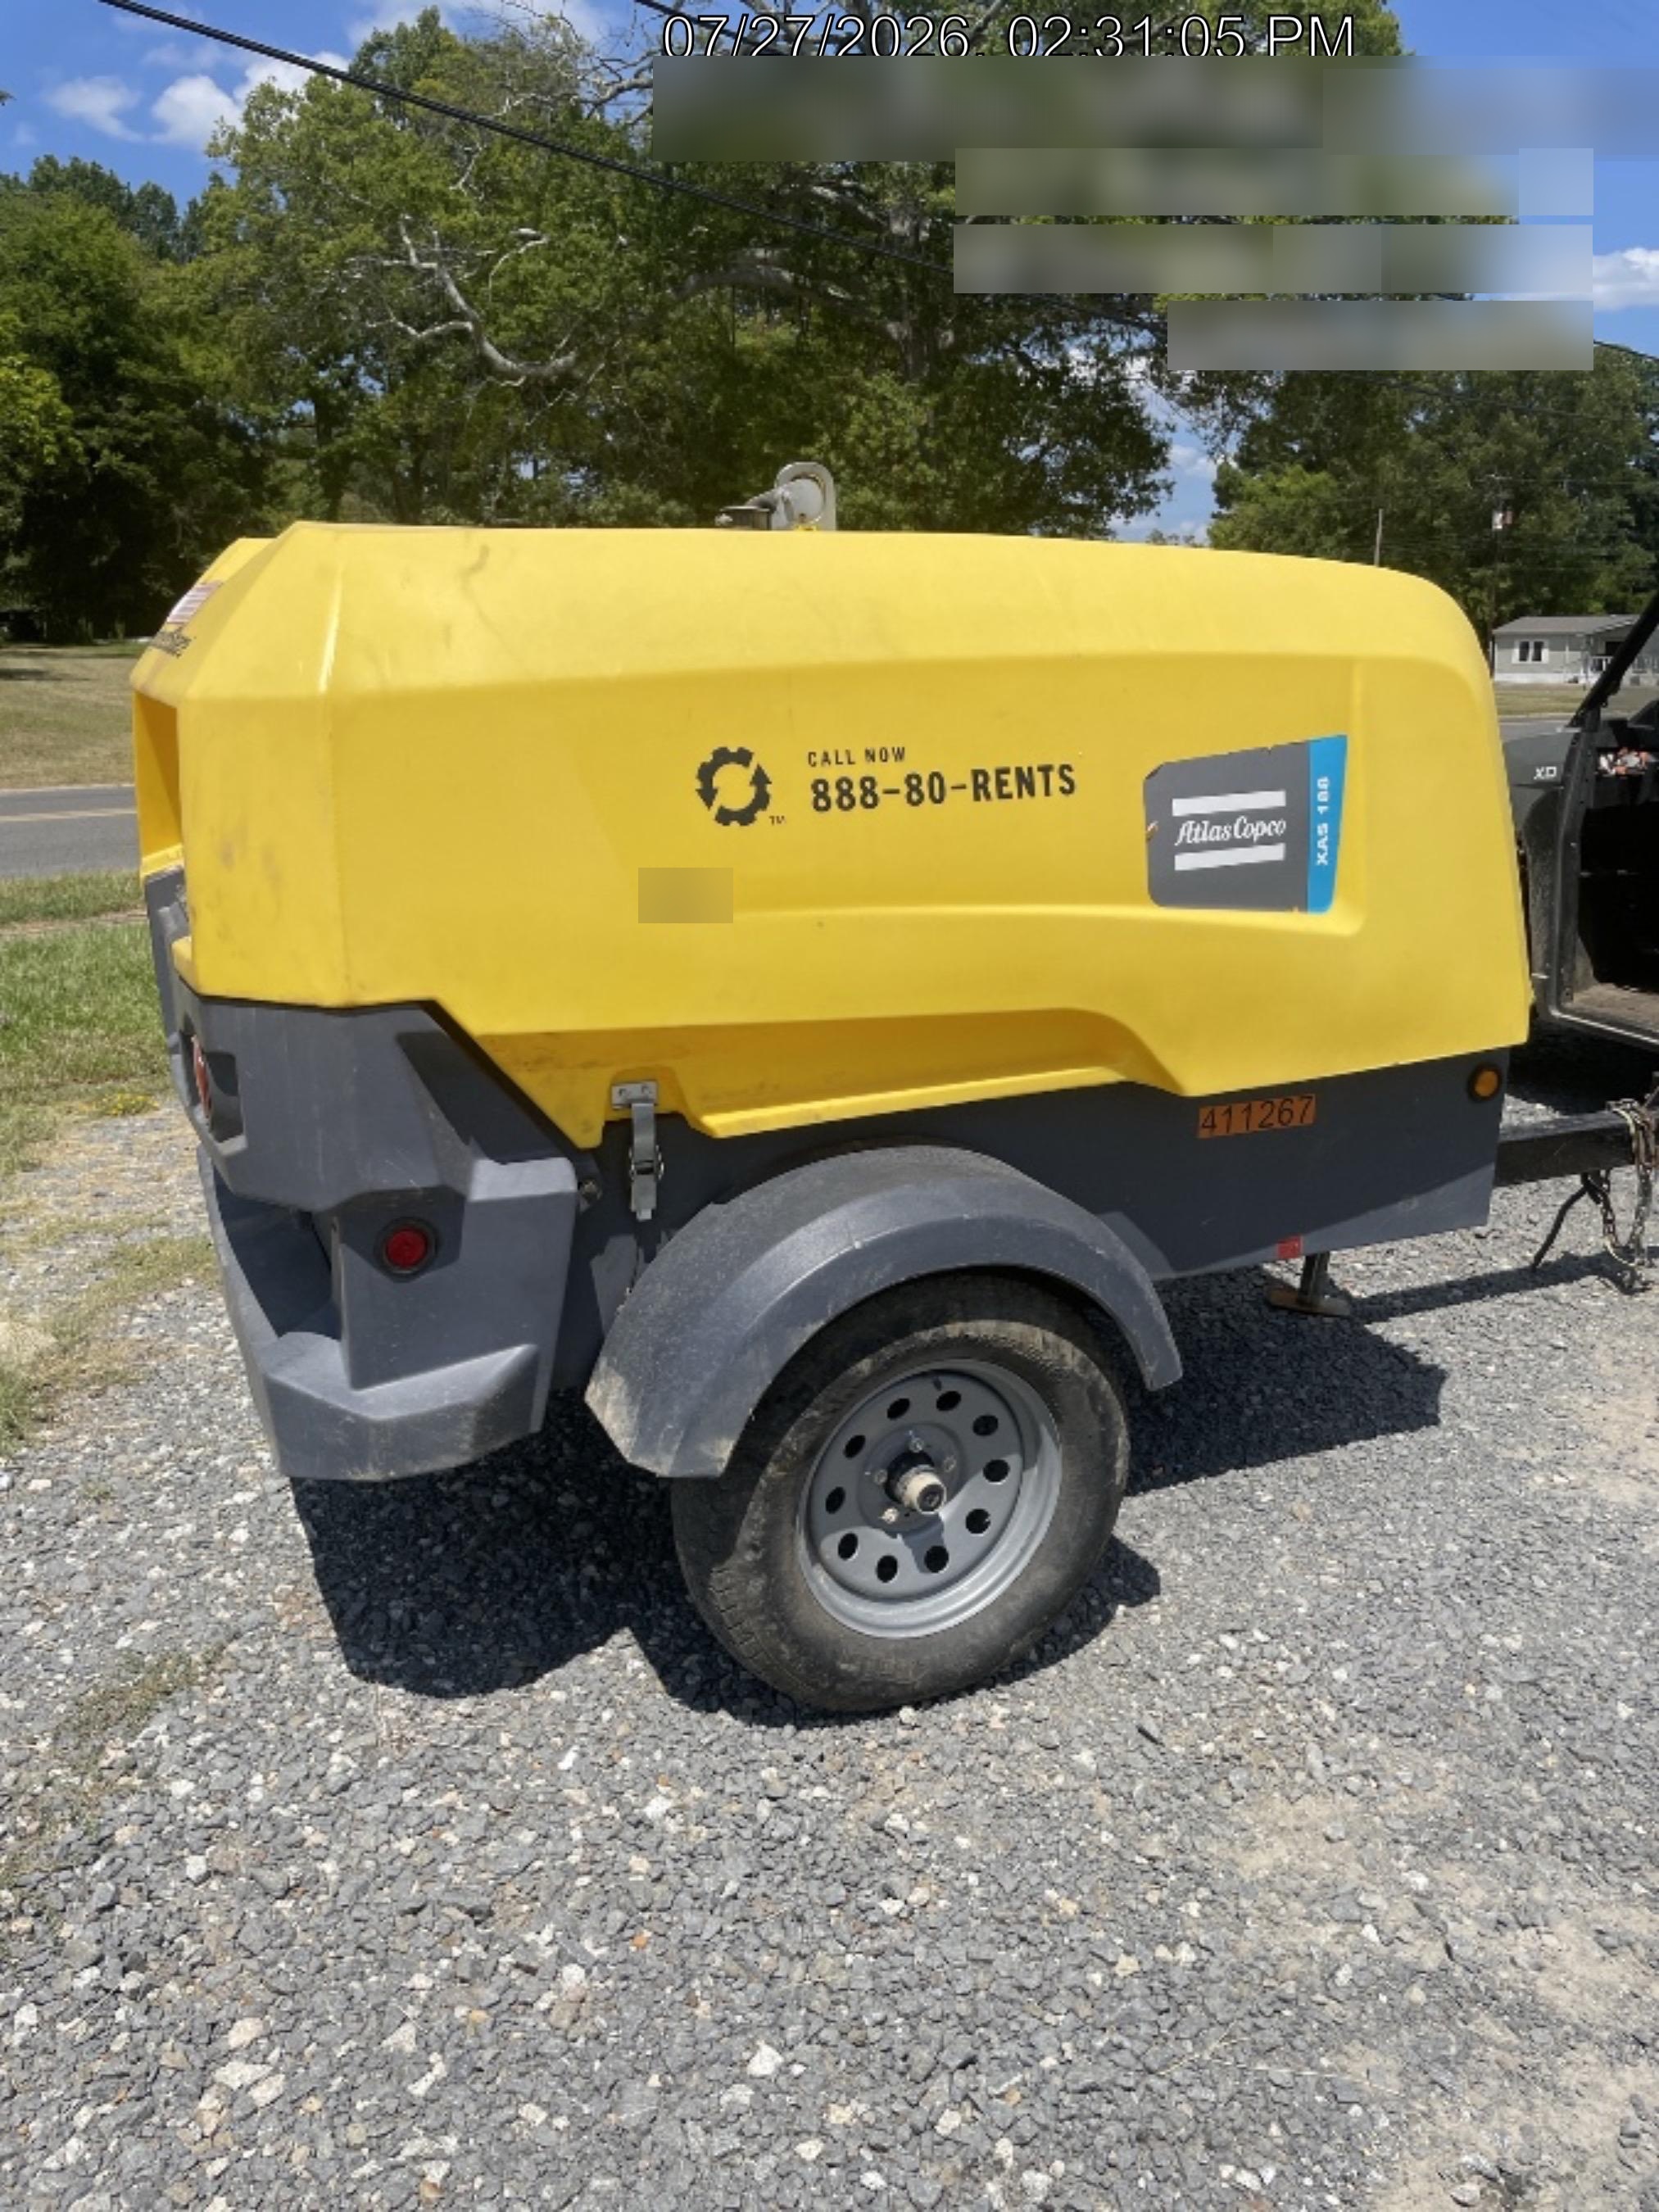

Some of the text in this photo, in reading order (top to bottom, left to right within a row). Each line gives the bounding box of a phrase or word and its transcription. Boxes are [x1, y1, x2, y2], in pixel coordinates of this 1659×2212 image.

[807, 746, 906, 767] CALL NOW
[1534, 765, 1557, 779] XD
[810, 764, 1076, 812] 888-80-RENTS
[1173, 815, 1286, 847] Atlas Copco
[1316, 822, 1329, 865] XAS
[1201, 1095, 1312, 1134] 411267
